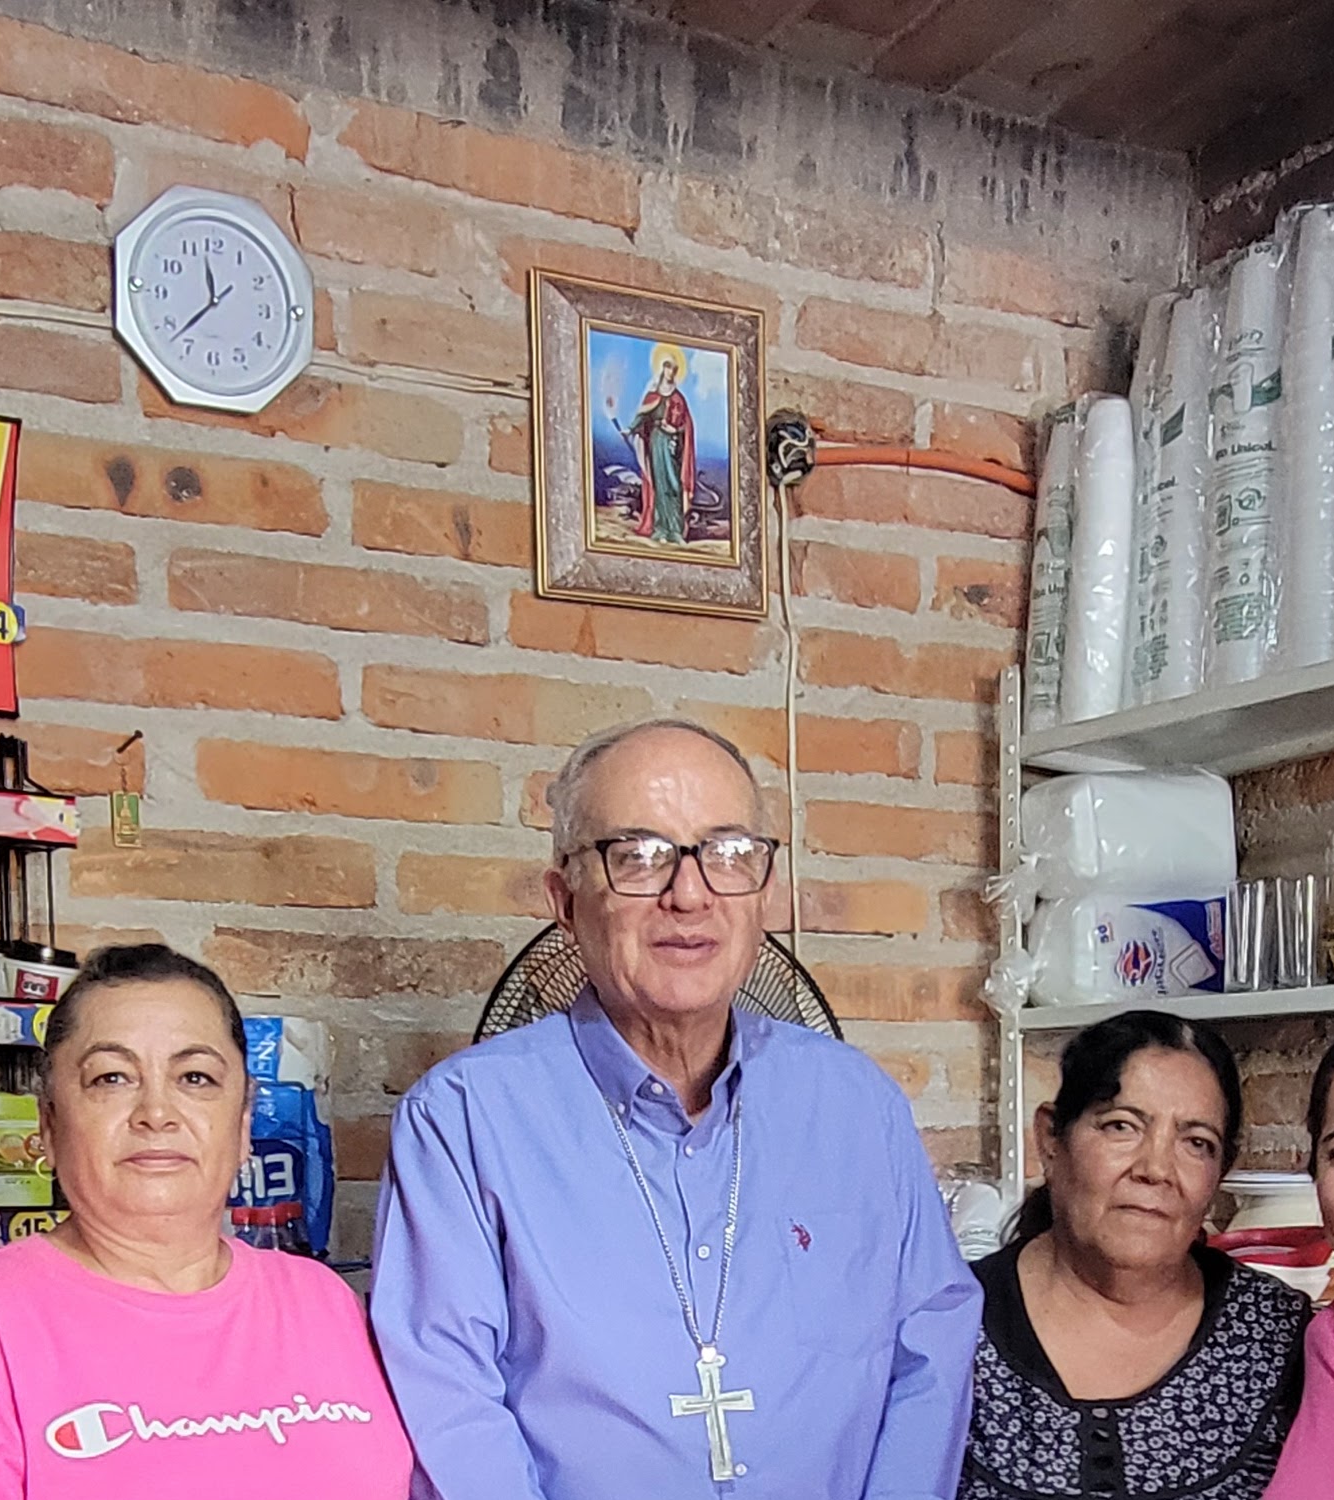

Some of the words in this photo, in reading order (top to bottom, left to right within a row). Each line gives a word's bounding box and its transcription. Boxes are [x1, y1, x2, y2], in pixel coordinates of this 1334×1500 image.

[182, 240, 197, 256] 11
[204, 237, 224, 254] 12
[236, 250, 243, 266] 1
[163, 258, 183, 275] 10
[252, 276, 264, 290] 2
[154, 285, 168, 299] 9
[258, 304, 271, 320] 3
[163, 316, 177, 330] 8
[251, 331, 263, 346] 4
[182, 339, 195, 356] 7
[206, 350, 220, 367] 6
[233, 348, 246, 364] 5
[45, 1394, 372, 1459] Champion
